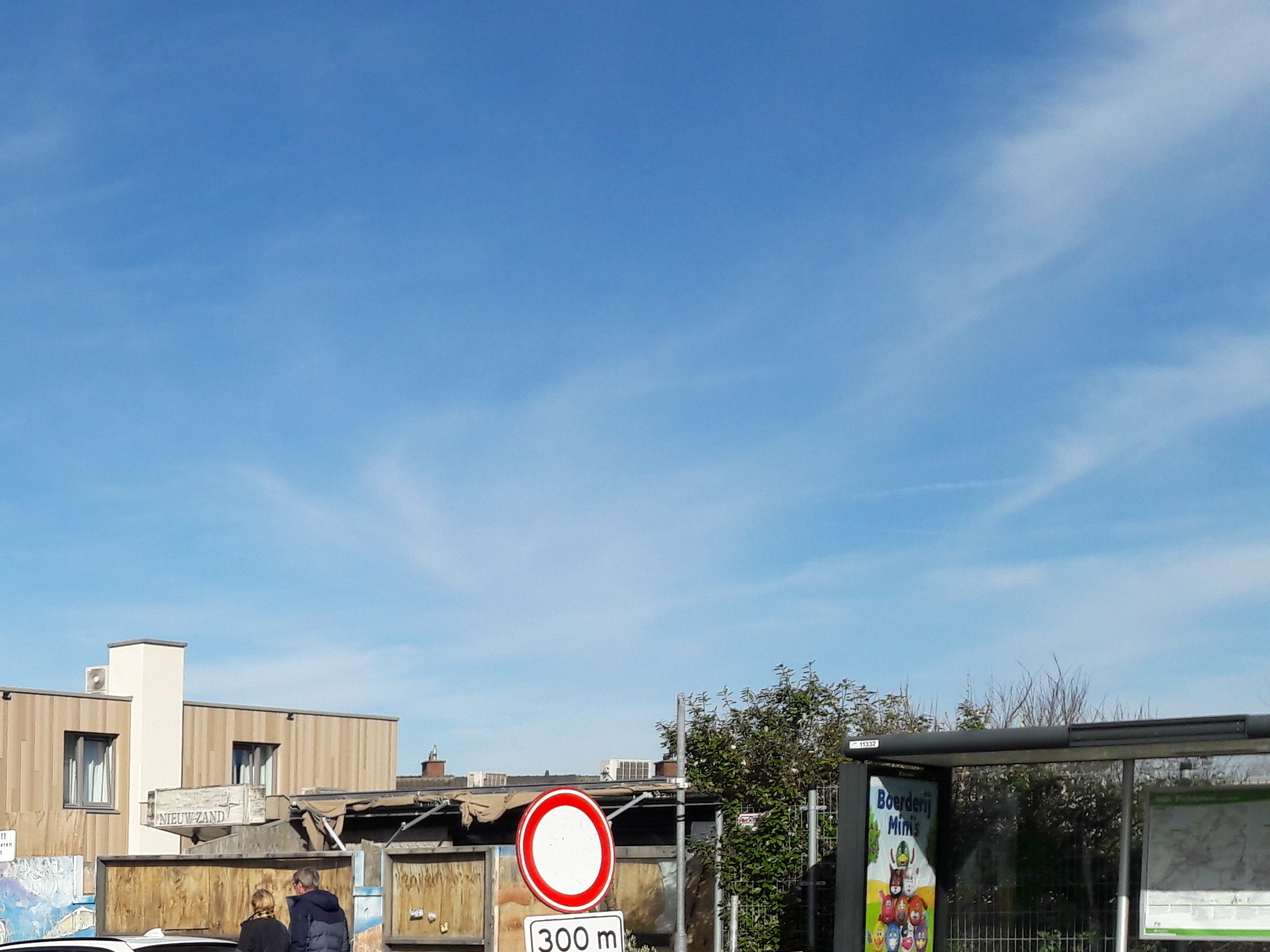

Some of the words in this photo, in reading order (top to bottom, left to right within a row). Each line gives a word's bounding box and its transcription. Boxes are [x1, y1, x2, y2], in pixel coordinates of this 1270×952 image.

[877, 788, 932, 819] Boerderij
[159, 812, 194, 825] NIEUW
[196, 810, 225, 824] ZAND
[597, 930, 617, 950] m
